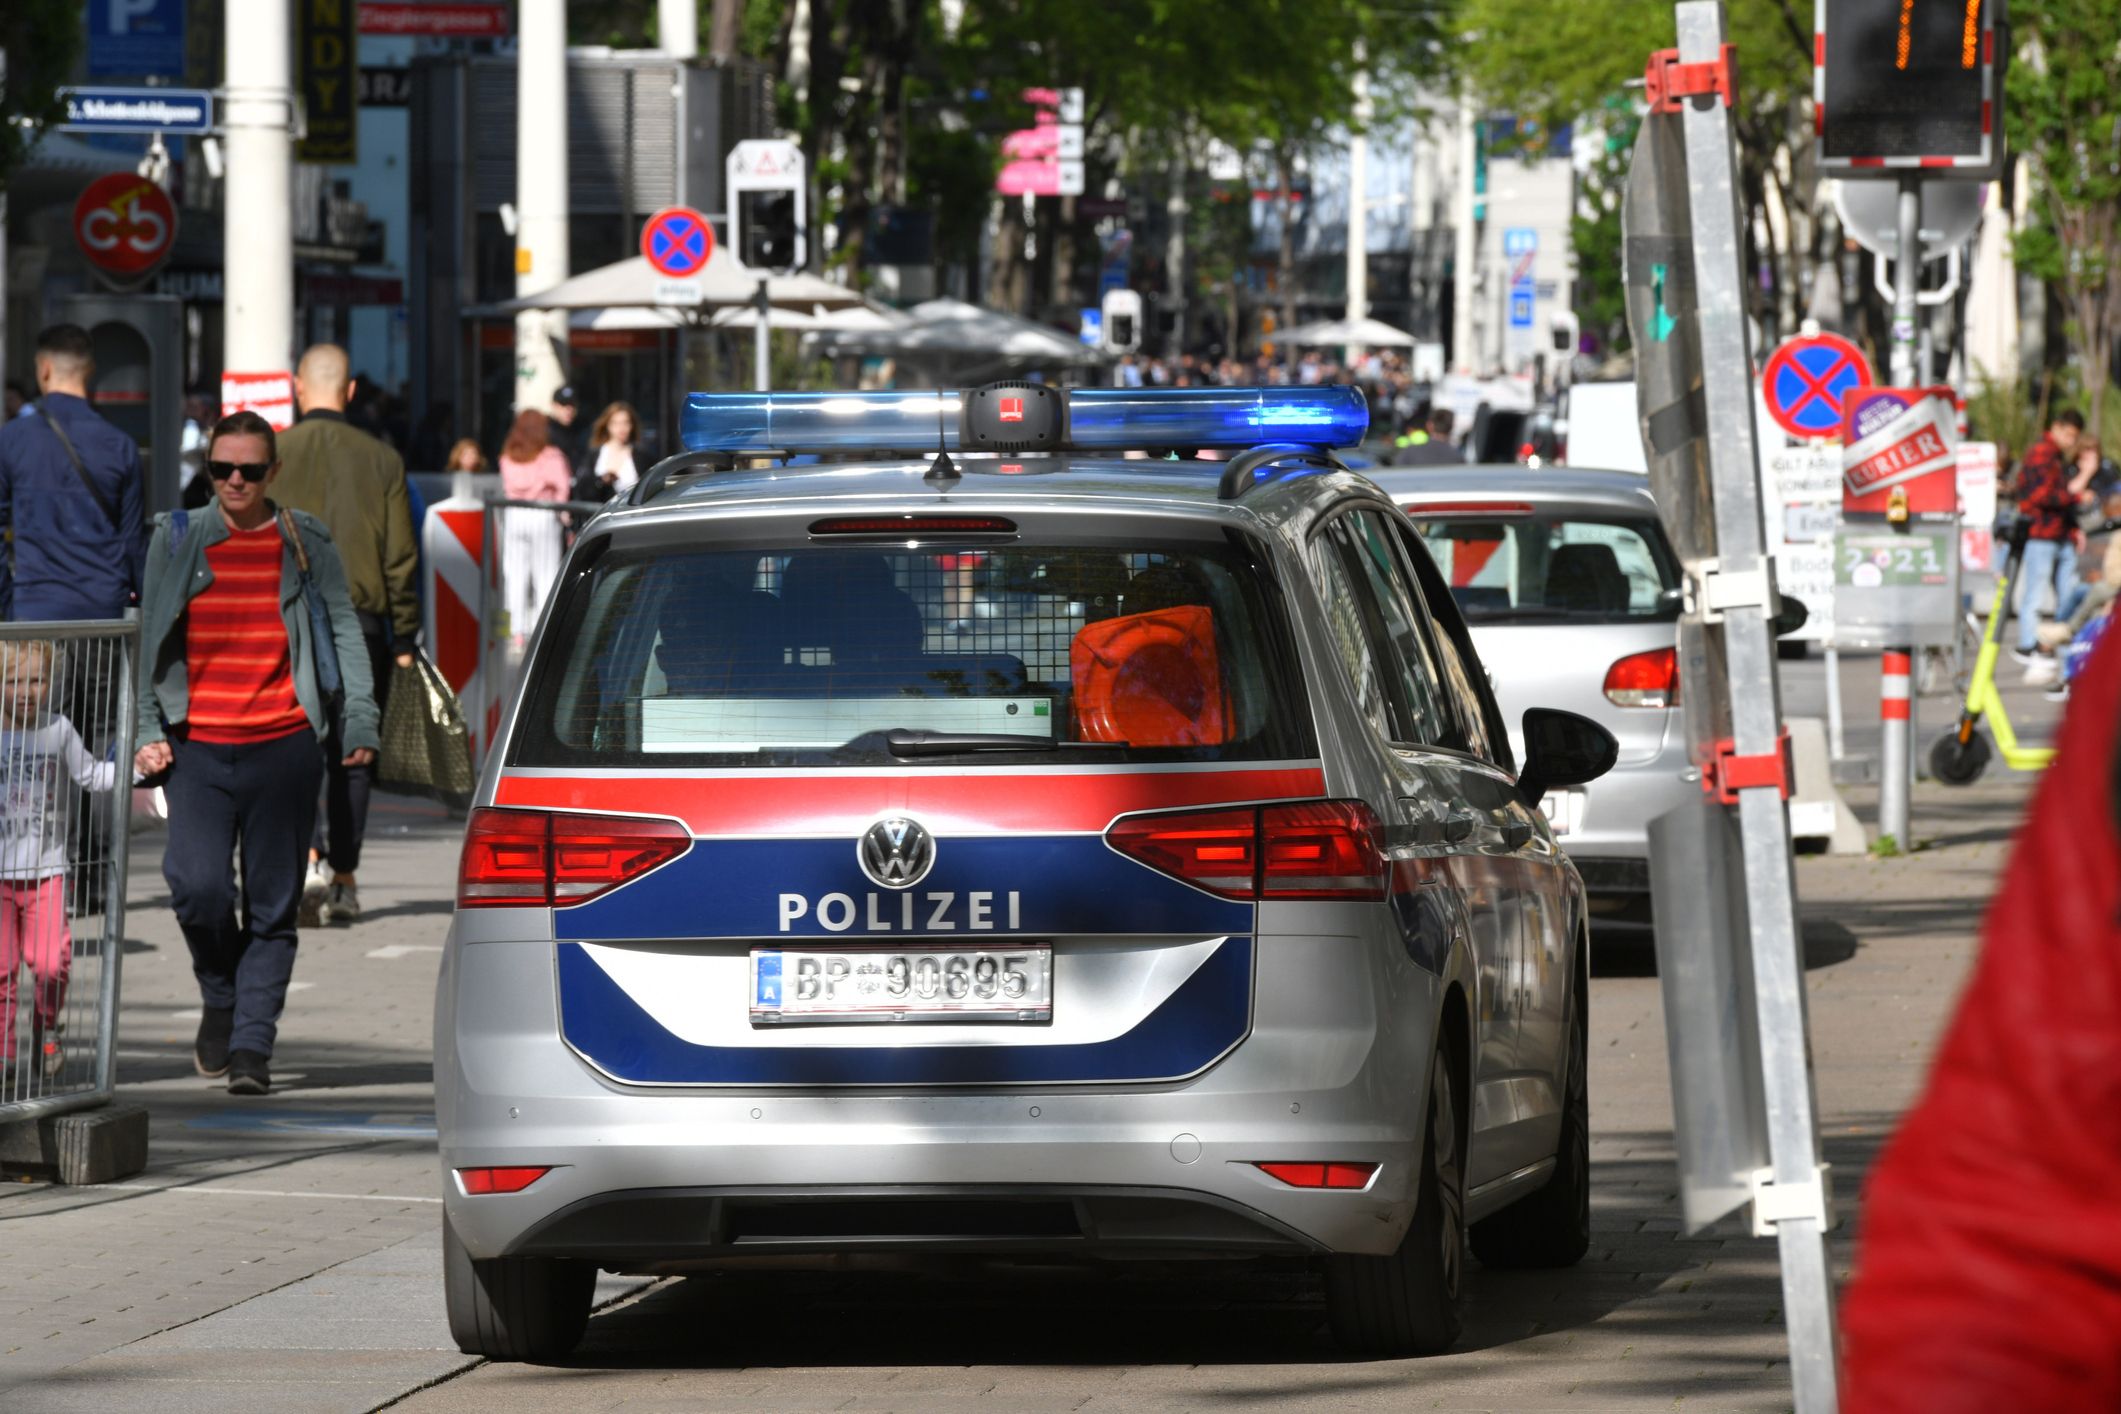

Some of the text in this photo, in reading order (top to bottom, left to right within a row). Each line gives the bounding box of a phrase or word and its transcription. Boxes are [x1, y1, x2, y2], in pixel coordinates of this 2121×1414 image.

[1850, 432, 1942, 486] KURIER
[778, 891, 1021, 931] POLIZEI
[796, 956, 851, 1000] BP
[886, 955, 1028, 1000] 90695
